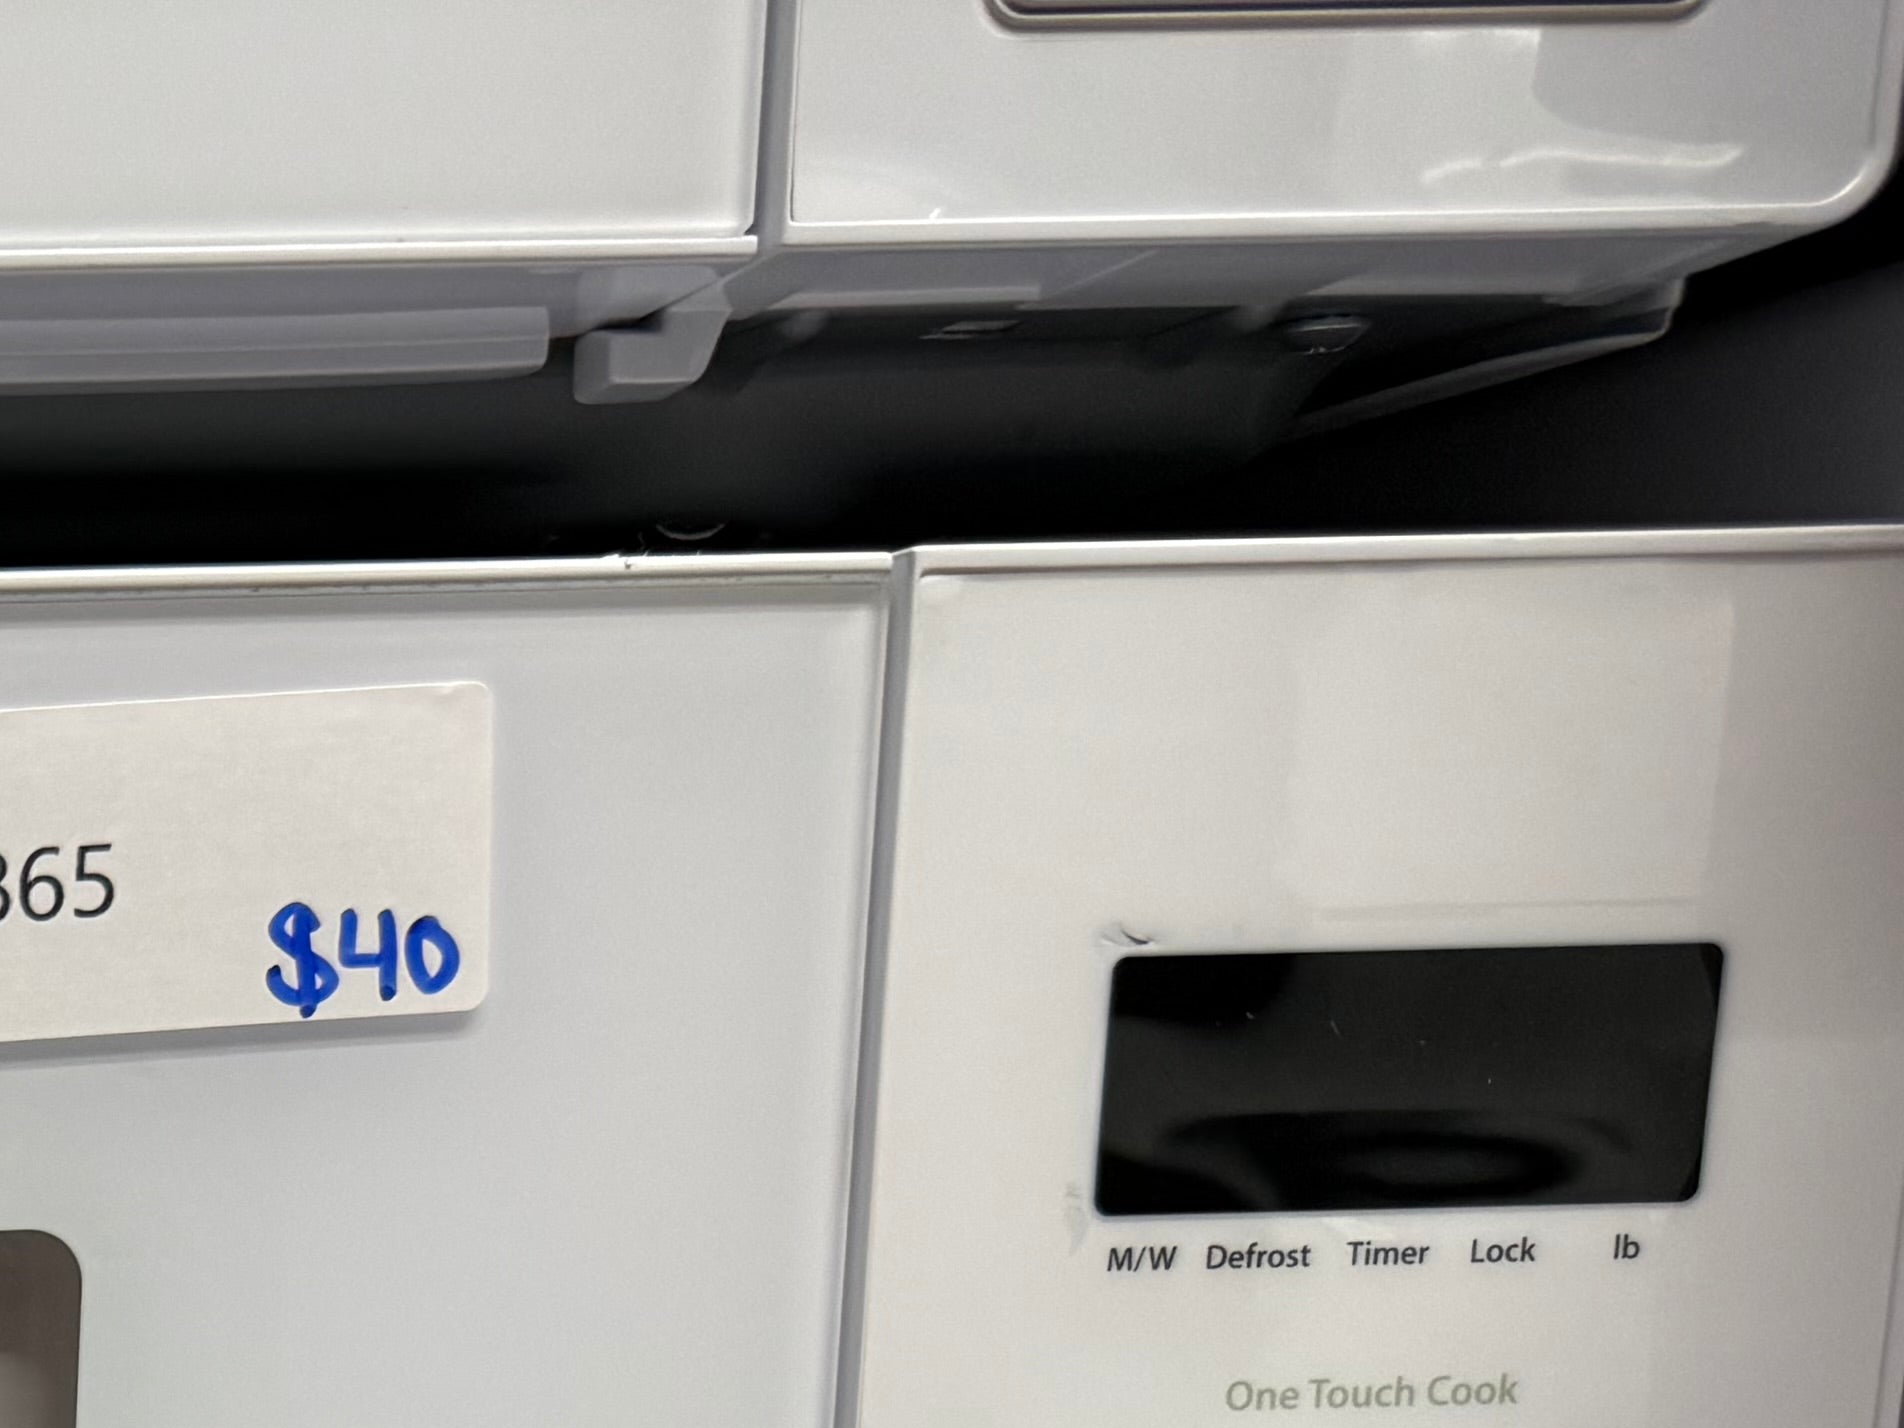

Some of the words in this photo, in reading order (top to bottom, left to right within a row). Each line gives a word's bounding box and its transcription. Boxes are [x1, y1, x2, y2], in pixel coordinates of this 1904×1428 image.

[266, 901, 461, 1019] $40
[1106, 1245, 1178, 1272] M/W
[1205, 1241, 1312, 1270] Defrost
[1346, 1240, 1431, 1266] Timer
[1470, 1236, 1536, 1264] Lock
[1613, 1233, 1642, 1260] lb
[1225, 1379, 1301, 1412] One
[1308, 1375, 1417, 1410] Touch
[1427, 1372, 1519, 1407] Cook
